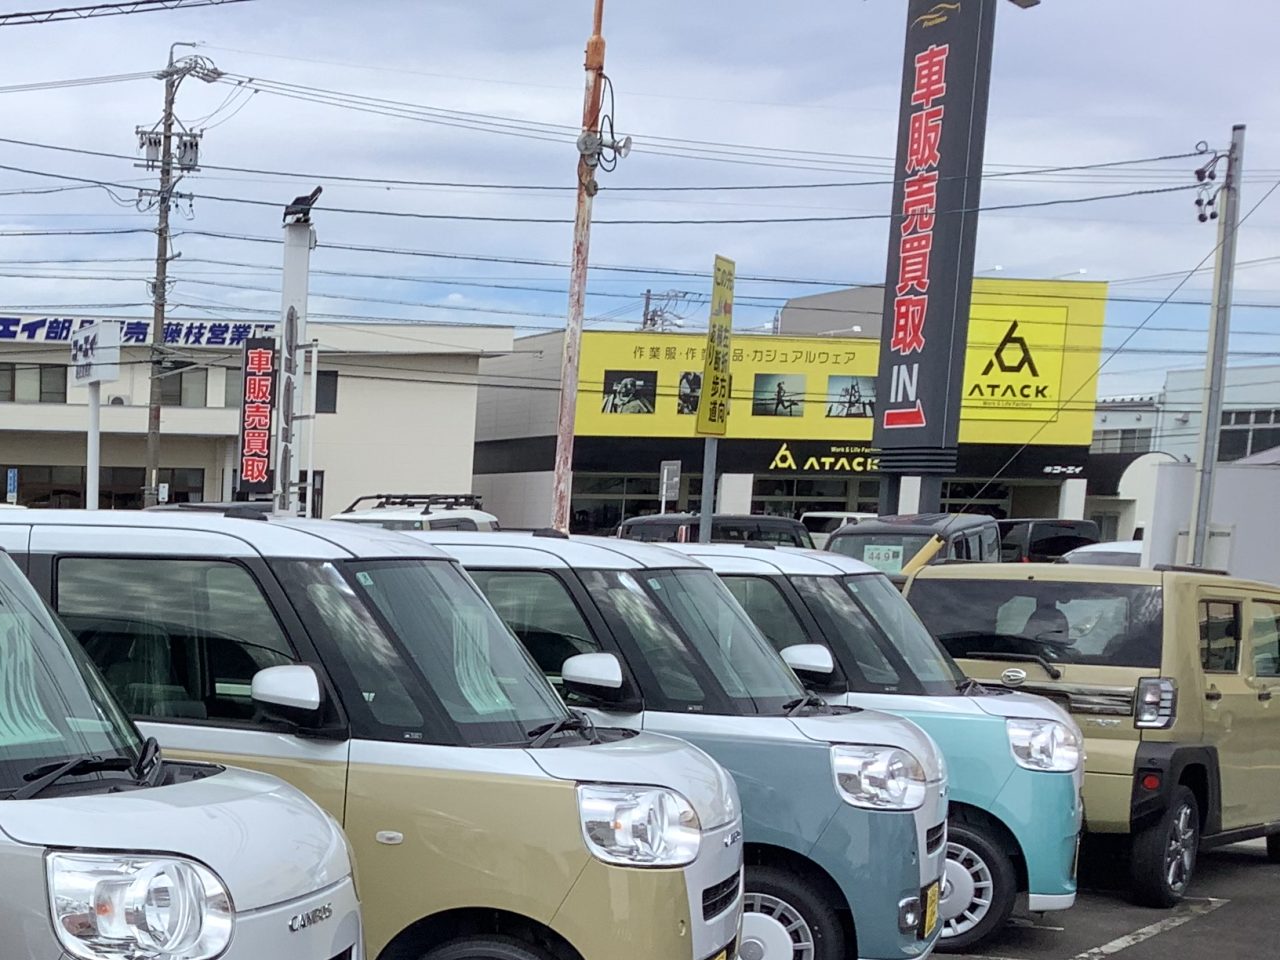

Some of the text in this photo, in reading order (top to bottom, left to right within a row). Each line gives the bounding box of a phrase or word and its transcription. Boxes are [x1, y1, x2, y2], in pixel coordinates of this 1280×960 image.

[890, 44, 949, 356] 車販売買取
[633, 346, 856, 365] 作業服・作品・カジュアルウェア
[708, 324, 723, 423] 横断歩道
[890, 363, 919, 403] IN
[968, 384, 1049, 398] ATACK
[242, 348, 273, 482] 車販売買取
[803, 457, 881, 471] ATACK
